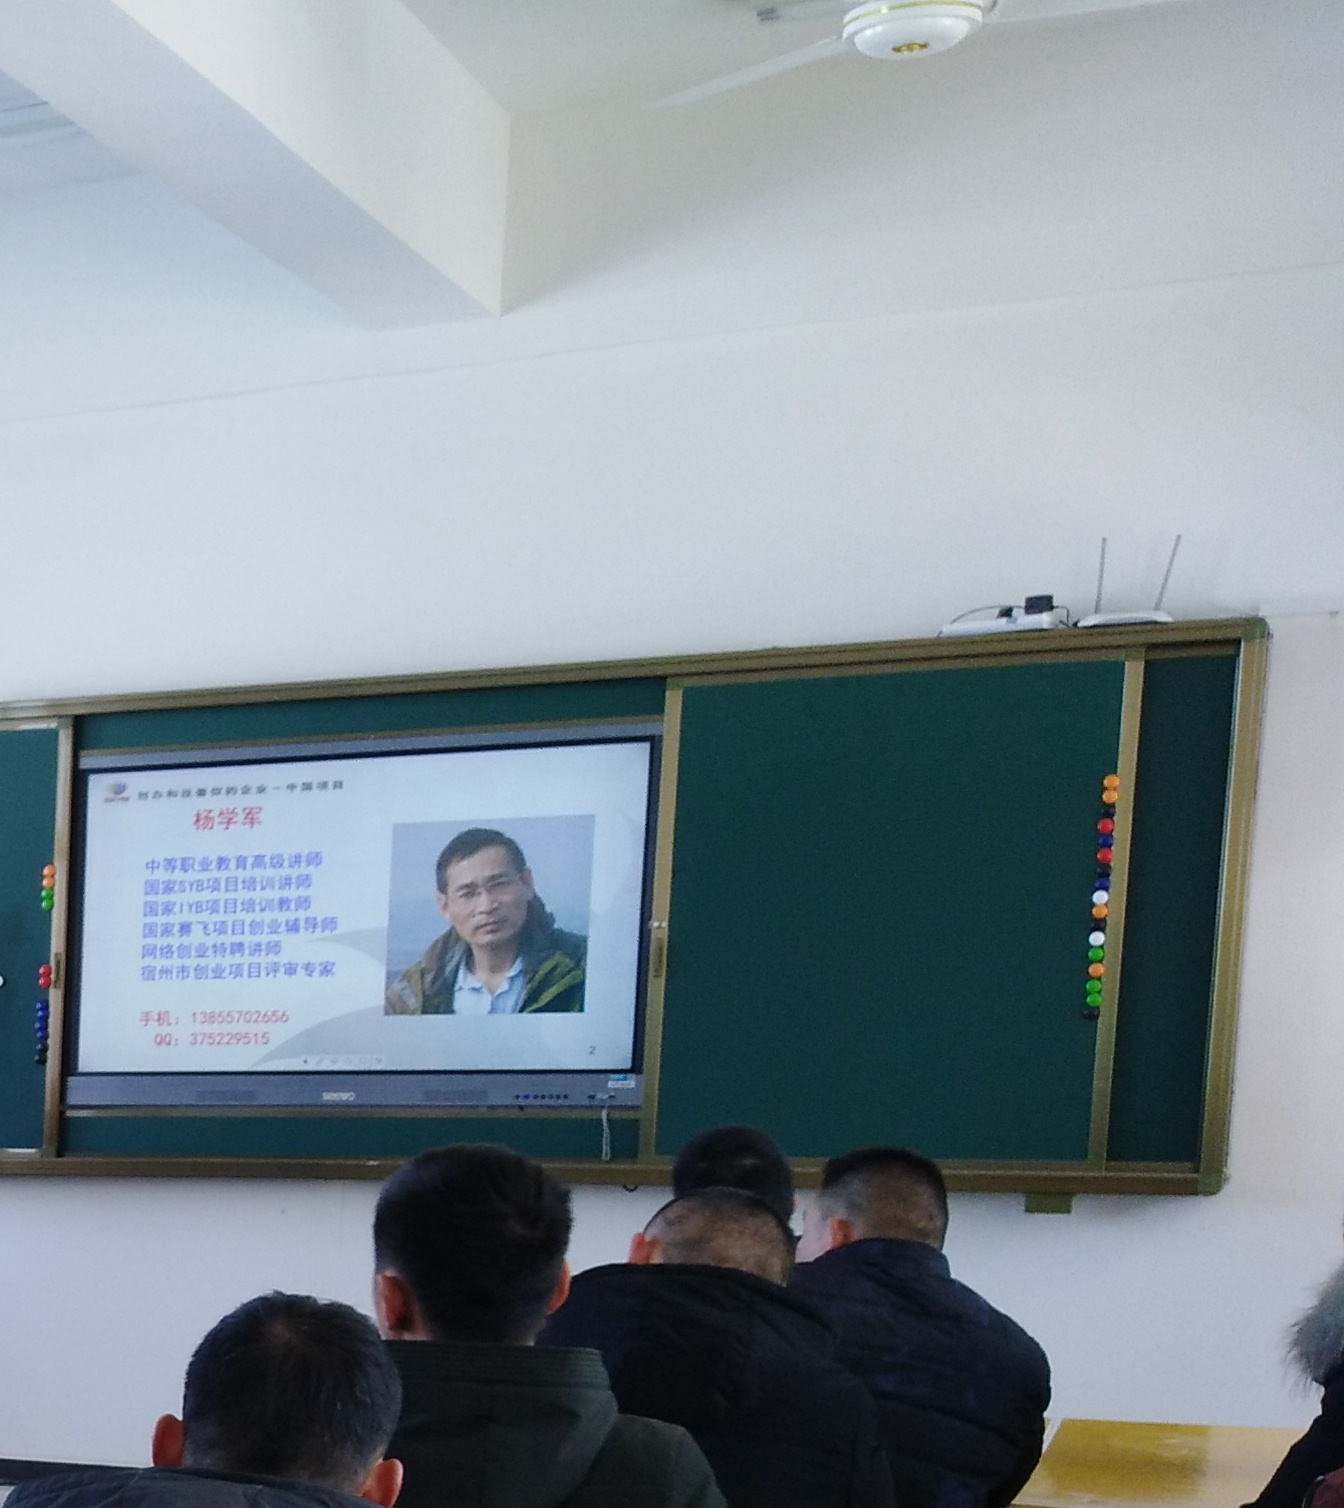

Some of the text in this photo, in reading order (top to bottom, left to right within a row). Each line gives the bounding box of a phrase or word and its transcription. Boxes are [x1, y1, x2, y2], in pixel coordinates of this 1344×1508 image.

[193, 806, 263, 831] 杨学军
[145, 851, 324, 874] 中等职业教育高级讲师
[143, 873, 313, 896] 国家SYB项目培训讲师
[141, 940, 282, 960] 网络创业特聘讲师
[141, 961, 337, 982] 宿州市创业项目评审专家
[589, 1045, 596, 1055] 2
